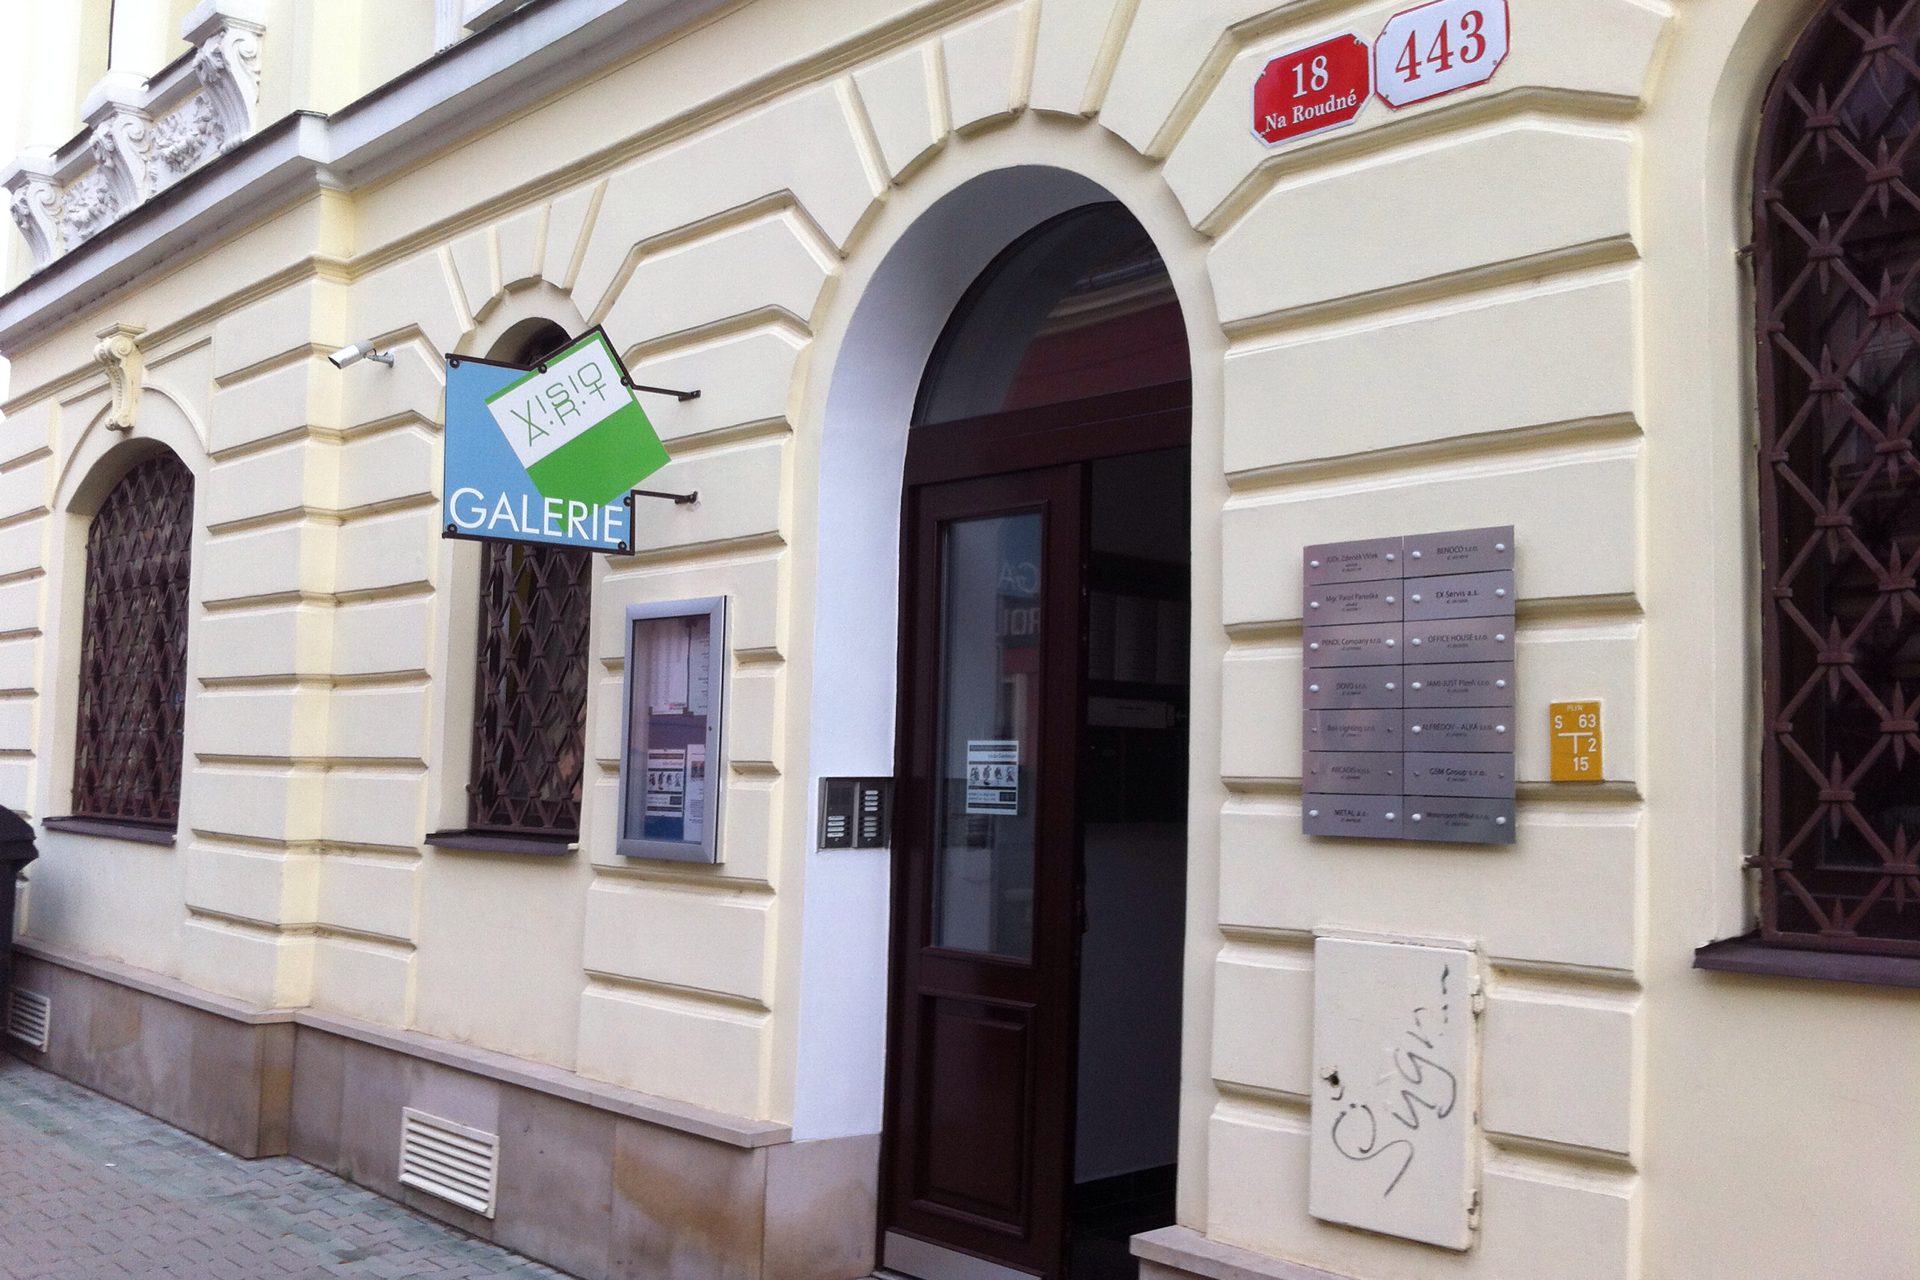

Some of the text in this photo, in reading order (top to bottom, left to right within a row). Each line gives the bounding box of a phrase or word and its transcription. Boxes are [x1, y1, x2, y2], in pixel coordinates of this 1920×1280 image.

[1395, 9, 1486, 84] 443
[1292, 55, 1329, 98] 18
[1264, 88, 1357, 133] Na Roudné
[450, 487, 623, 543] GALERIE
[1555, 714, 1596, 729] S 63
[1573, 757, 1589, 771] 15
[1588, 737, 1597, 752] 2
